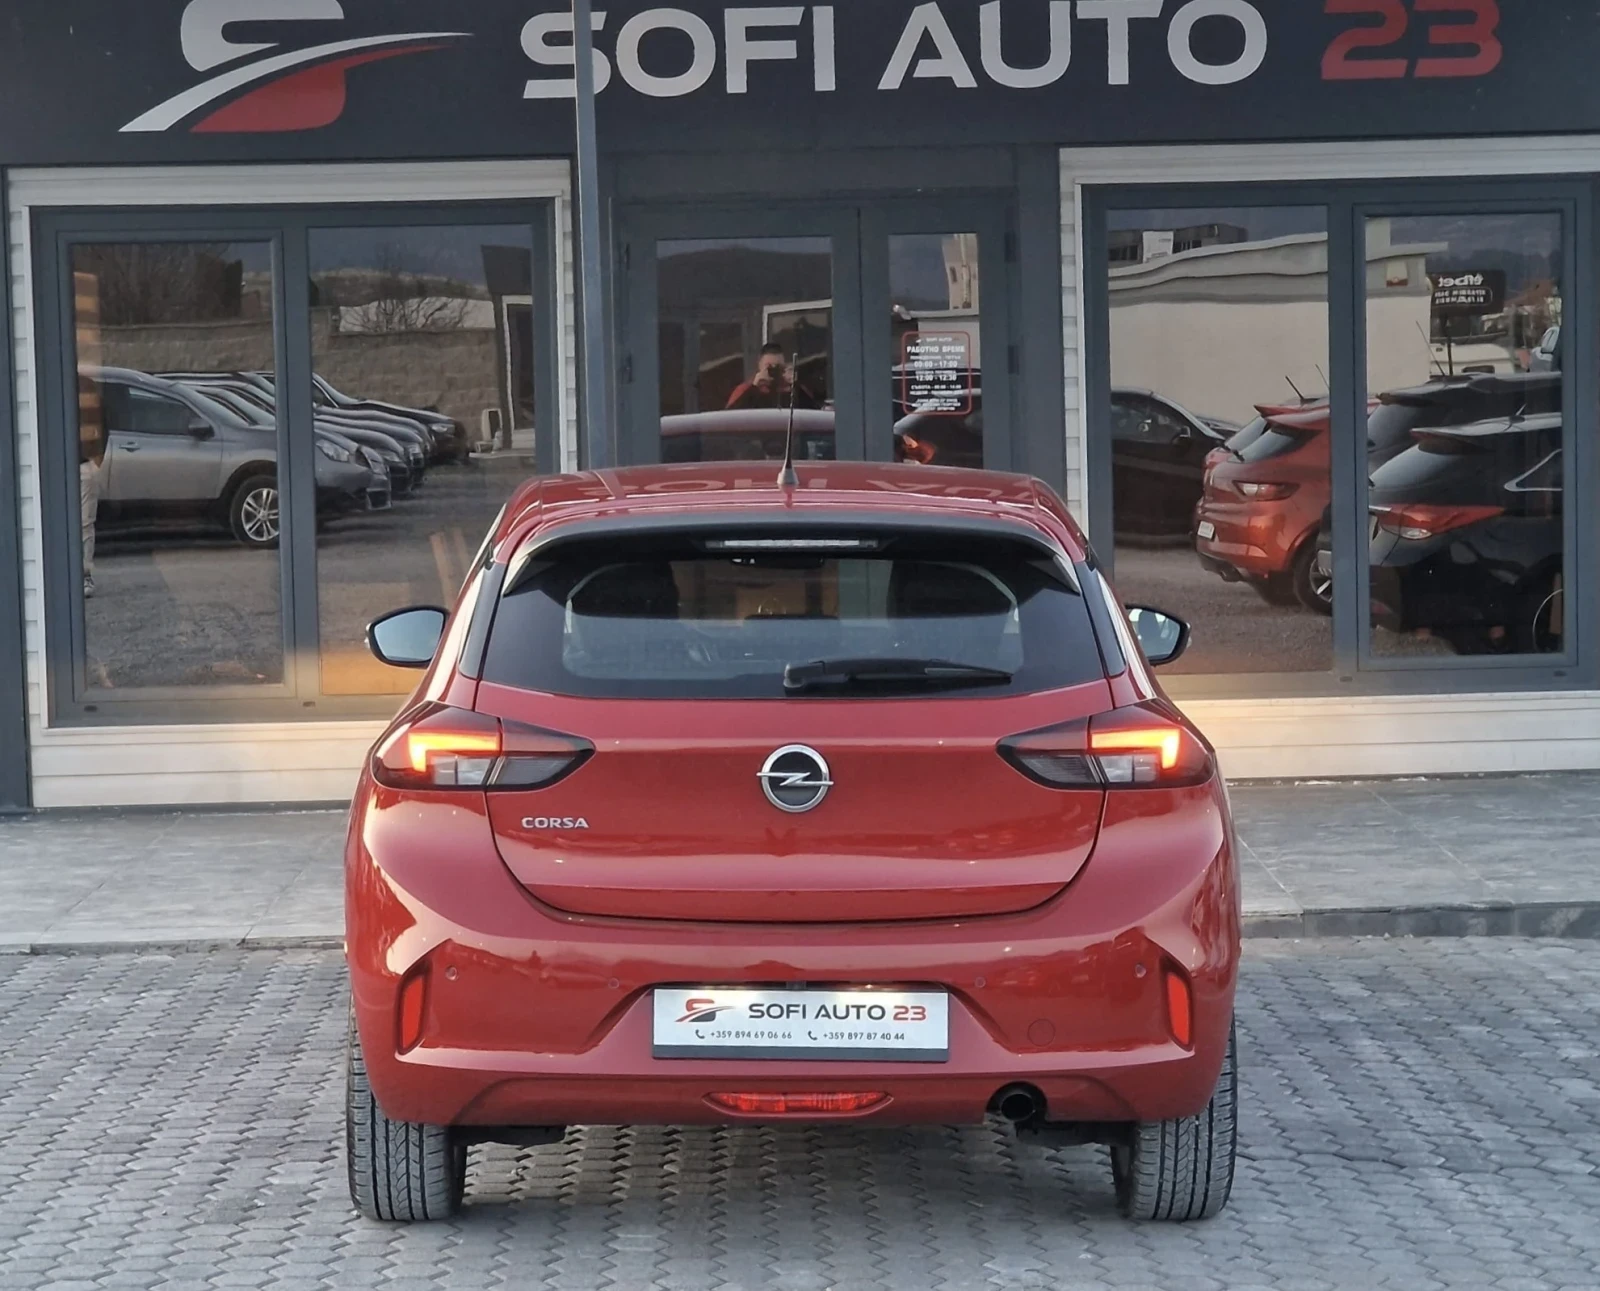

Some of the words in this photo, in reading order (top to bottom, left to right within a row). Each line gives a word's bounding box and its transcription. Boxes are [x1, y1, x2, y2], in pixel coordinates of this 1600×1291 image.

[520, 5, 836, 98] SOFI
[877, 0, 1267, 90] AUTO
[1320, 0, 1503, 80] 23
[521, 817, 589, 829] CORSA
[748, 1003, 807, 1020] SOFI
[814, 1004, 886, 1021] AUTO
[893, 1006, 927, 1021] 23
[710, 1030, 732, 1039] +359
[734, 1030, 752, 1039] 894
[754, 1031, 765, 1039] 69
[767, 1031, 778, 1039] 06
[781, 1031, 792, 1039] 66
[823, 1032, 845, 1040] +359
[847, 1032, 864, 1040] 897
[866, 1032, 878, 1040] 87
[880, 1032, 891, 1041] 40
[893, 1033, 905, 1041] 44
